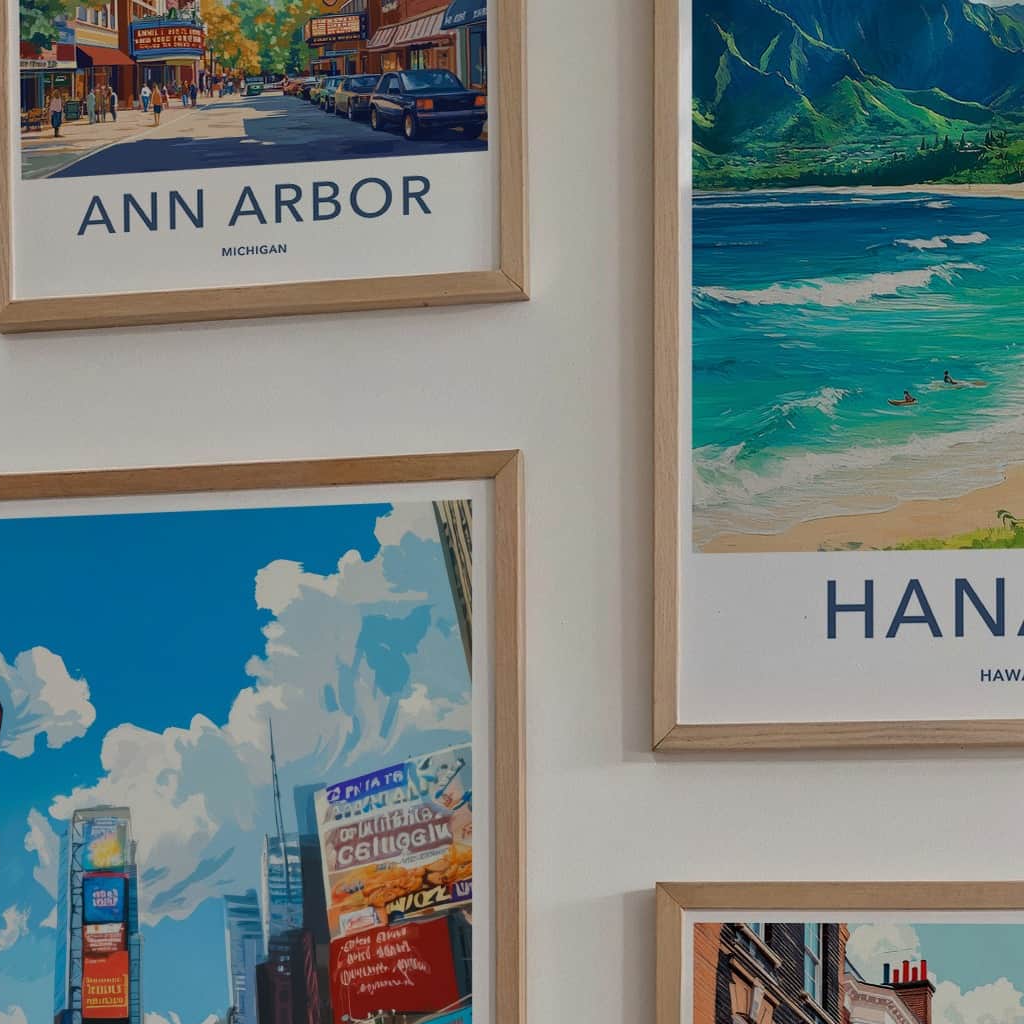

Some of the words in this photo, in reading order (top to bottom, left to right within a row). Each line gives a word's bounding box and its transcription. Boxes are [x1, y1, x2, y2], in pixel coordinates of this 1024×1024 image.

[77, 188, 205, 236] ANN
[228, 175, 432, 227] ARBOR
[221, 243, 288, 257] MICHIGAN
[827, 577, 1024, 640] HAN
[980, 668, 1024, 682] HAW
